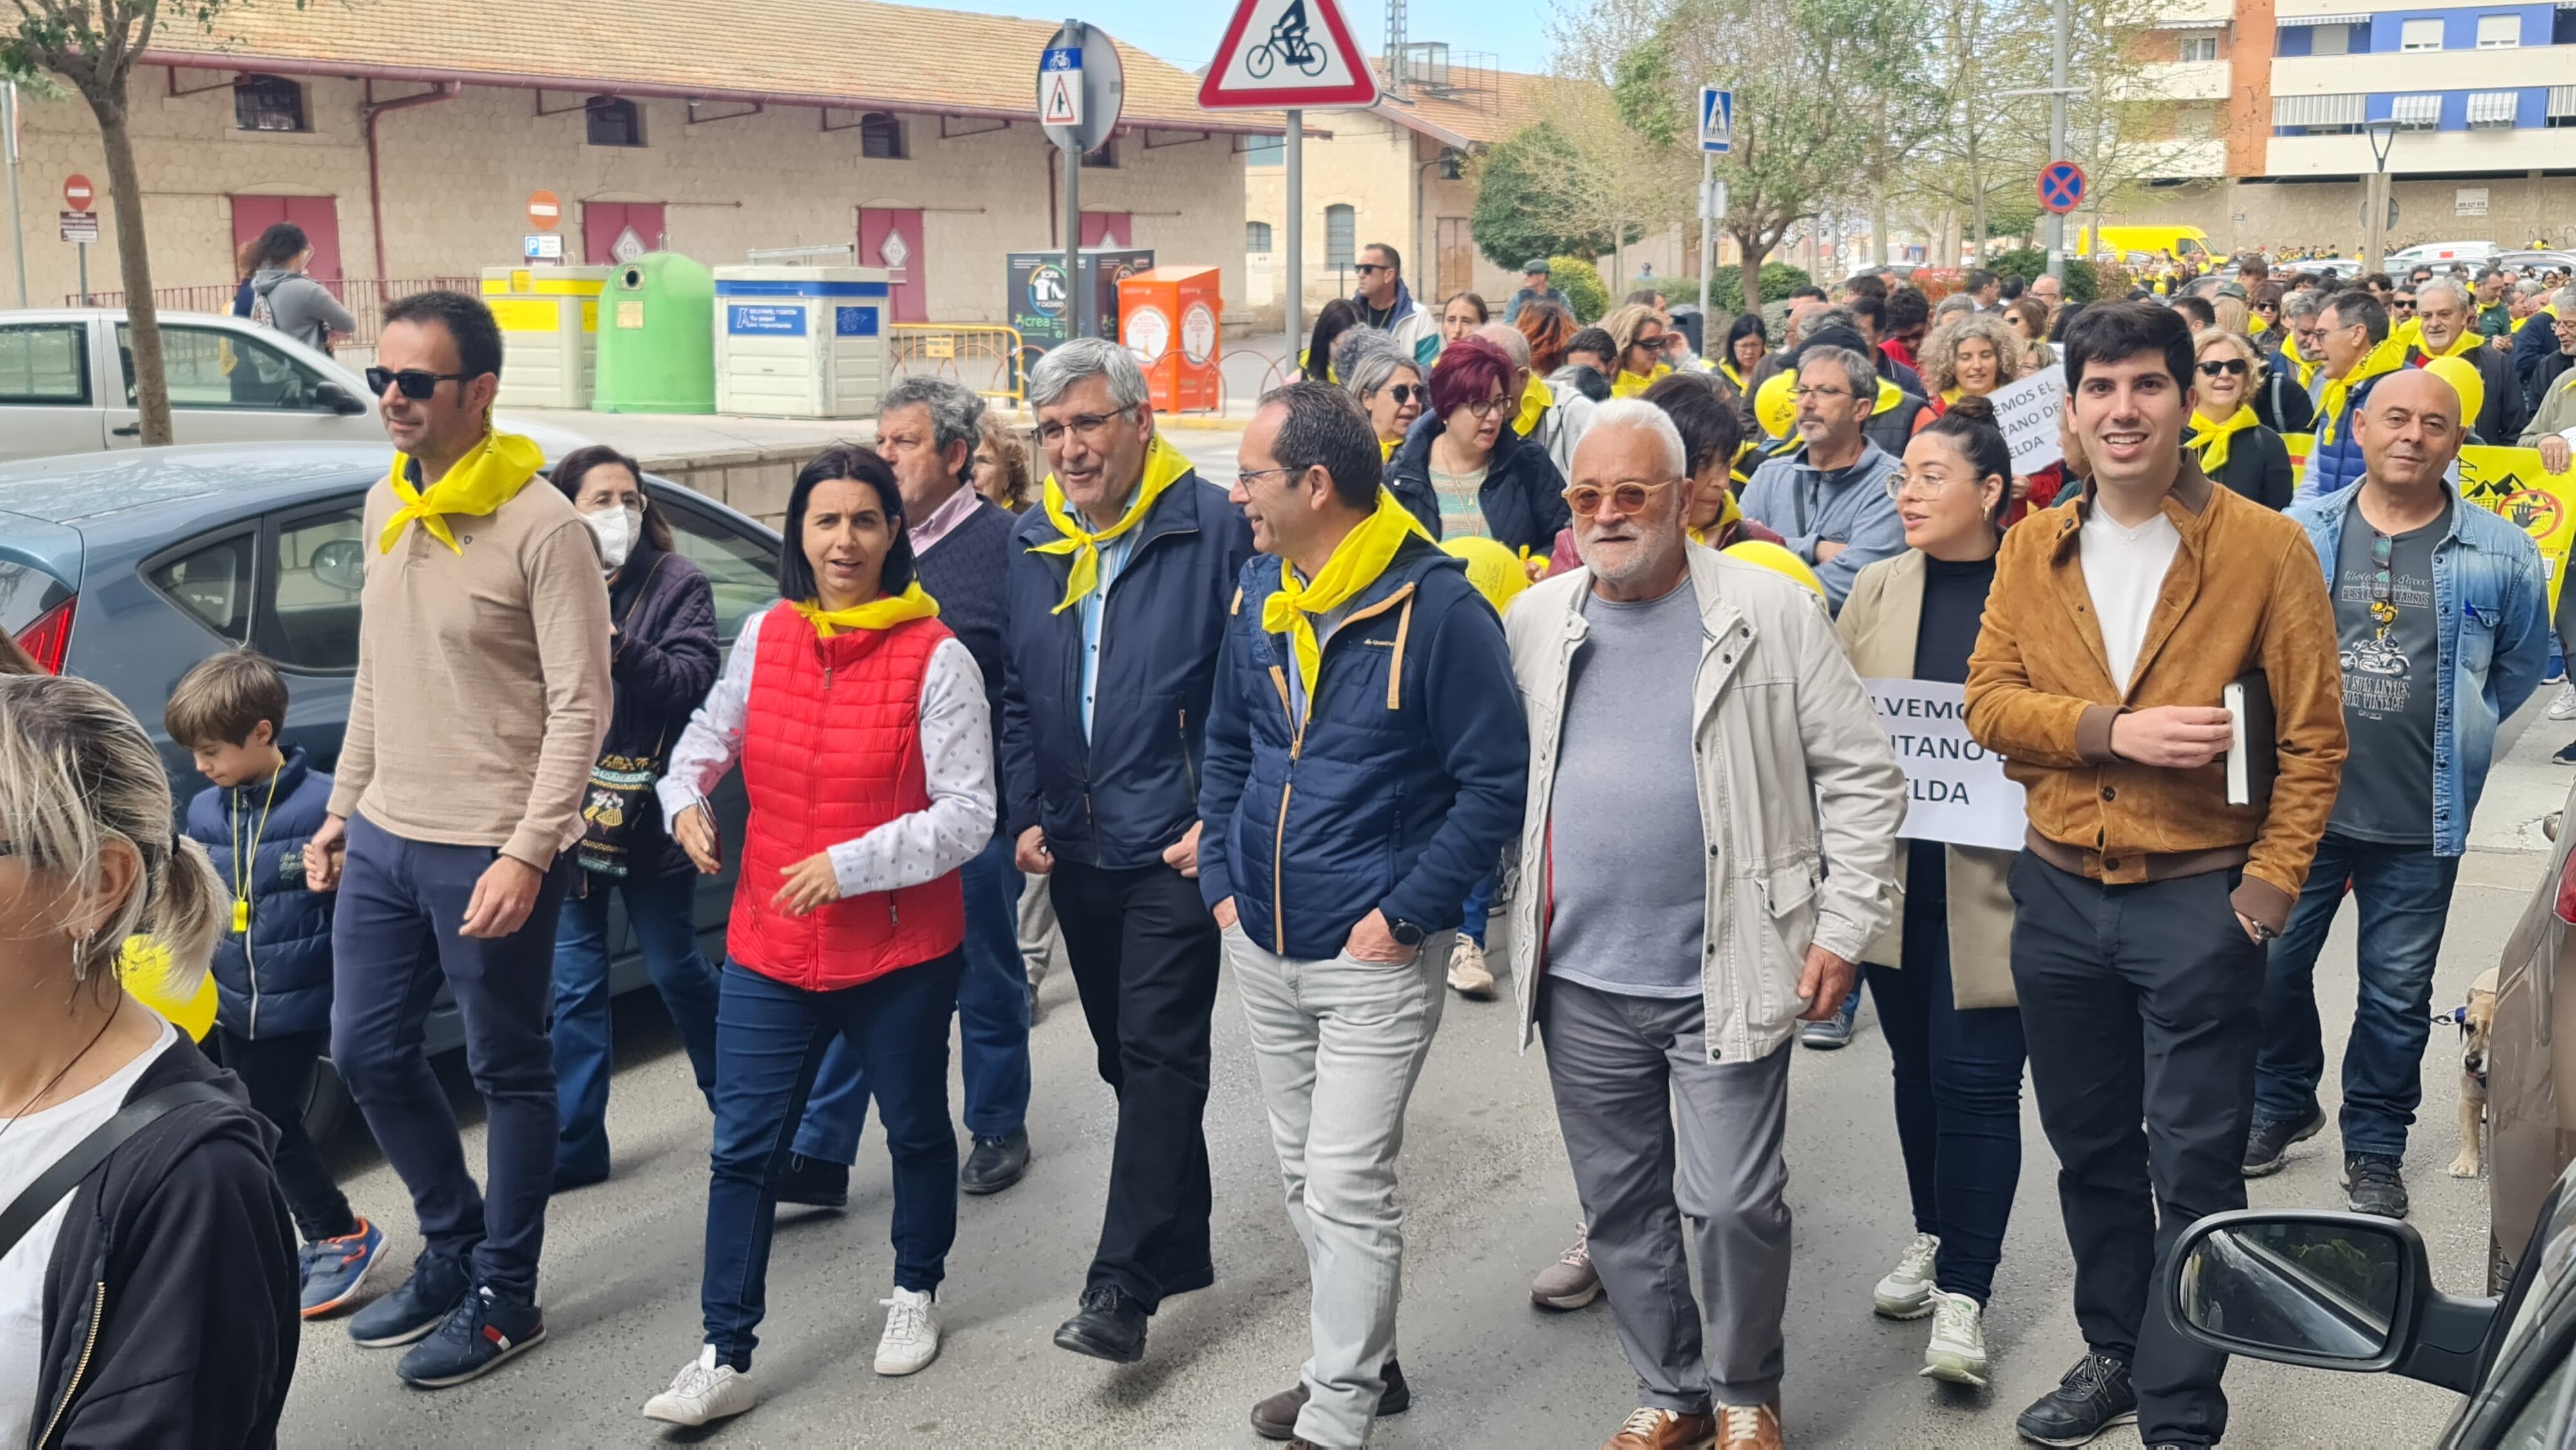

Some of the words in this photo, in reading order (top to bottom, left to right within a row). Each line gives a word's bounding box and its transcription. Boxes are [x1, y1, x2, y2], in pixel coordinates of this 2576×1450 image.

[528, 239, 538, 254] P
[1025, 317, 1051, 327] crea
[2037, 381, 2056, 395] EL
